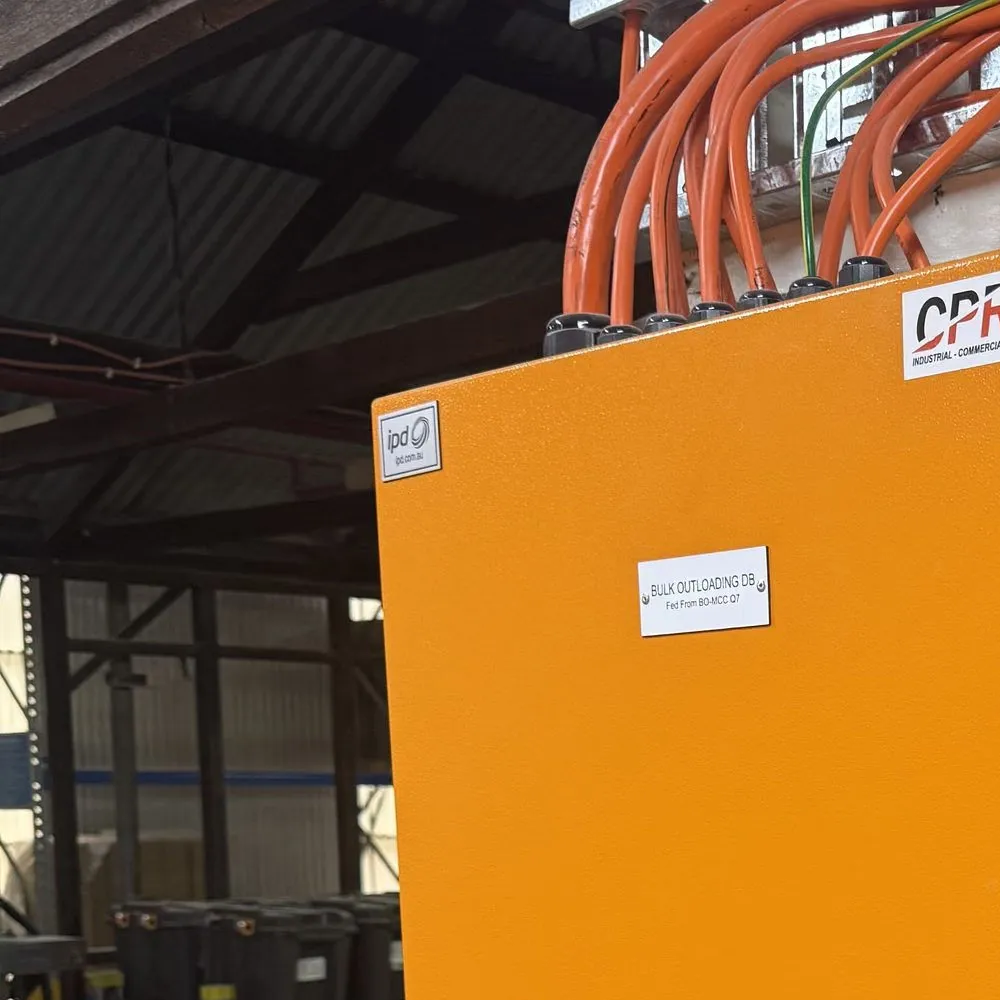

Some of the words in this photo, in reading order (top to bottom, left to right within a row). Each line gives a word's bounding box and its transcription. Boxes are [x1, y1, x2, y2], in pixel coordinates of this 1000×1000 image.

[912, 351, 952, 367] INDUSTRIAL
[388, 425, 409, 454] ipd
[395, 453, 424, 467] ipd.com.au
[651, 582, 675, 597] BULK
[677, 575, 739, 594] OUTLOADING
[741, 572, 756, 587] DB
[666, 601, 679, 610] Fed
[680, 599, 697, 609] From
[698, 595, 729, 607] BO-MCC
